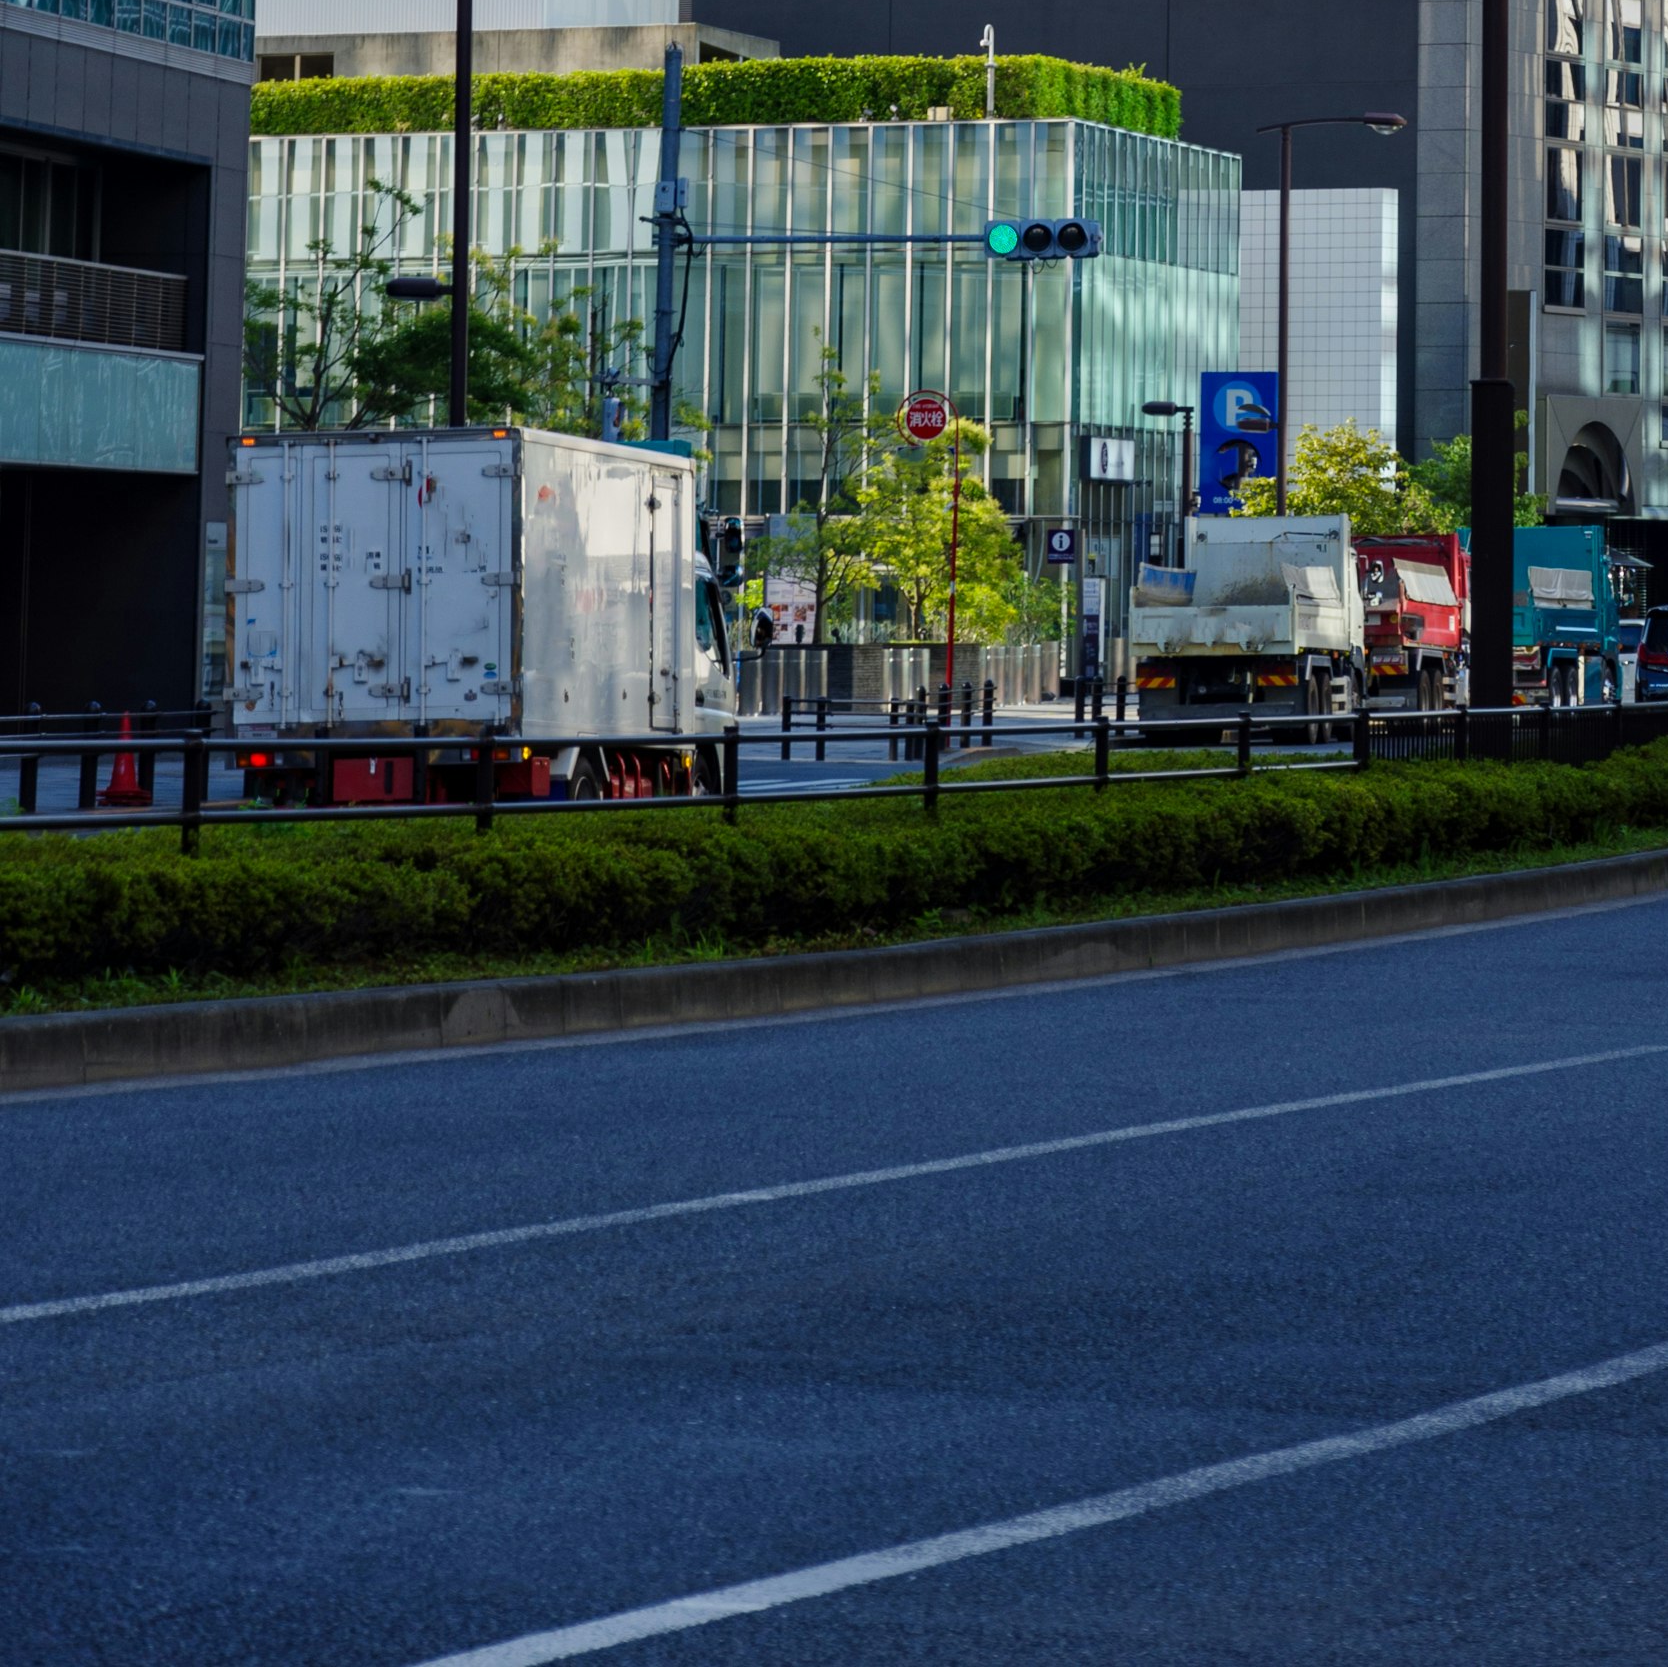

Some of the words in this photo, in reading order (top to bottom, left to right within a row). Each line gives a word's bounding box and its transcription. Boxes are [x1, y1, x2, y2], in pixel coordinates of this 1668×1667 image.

[909, 410, 944, 428] 消火栓
[1225, 388, 1254, 427] P
